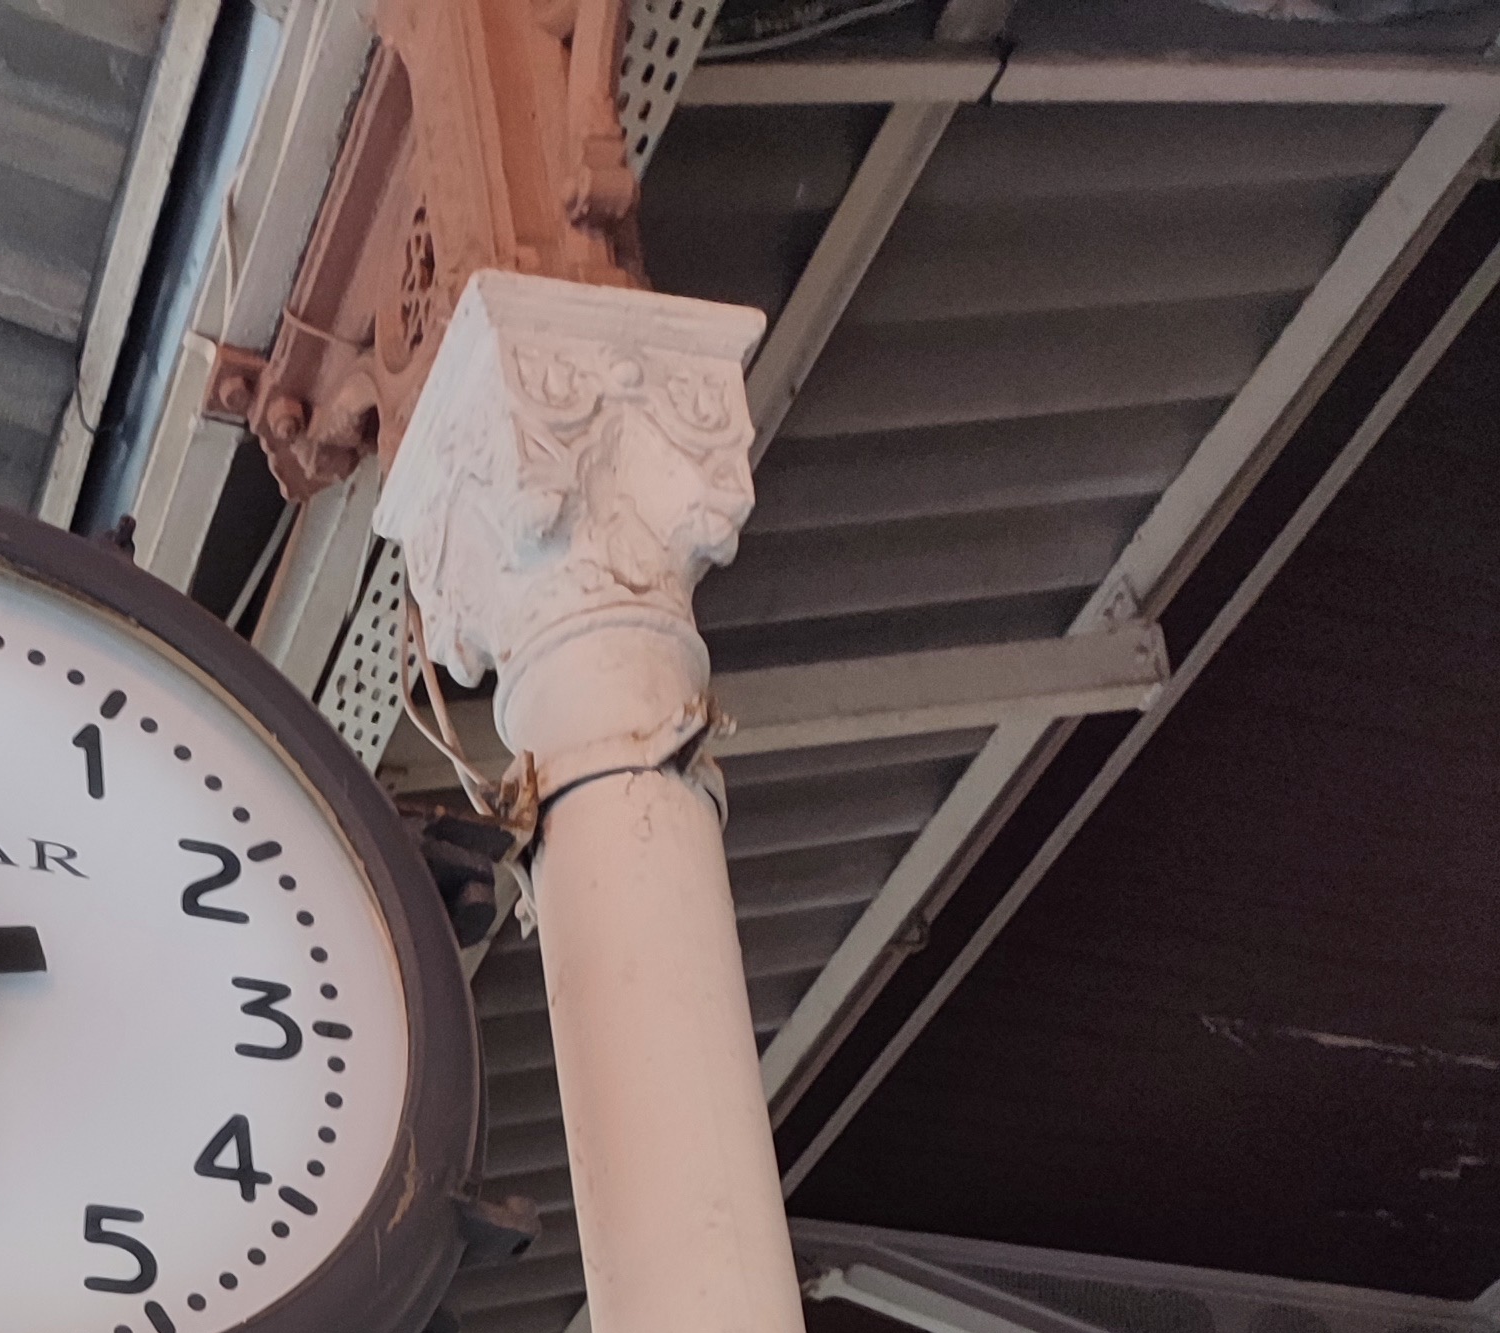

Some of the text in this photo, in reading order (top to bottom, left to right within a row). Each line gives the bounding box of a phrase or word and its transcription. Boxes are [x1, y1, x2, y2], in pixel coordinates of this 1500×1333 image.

[72, 723, 105, 800] 1
[178, 838, 250, 925] 2
[231, 976, 304, 1061] 3
[193, 1114, 273, 1203] 4
[83, 1204, 158, 1296] 5
